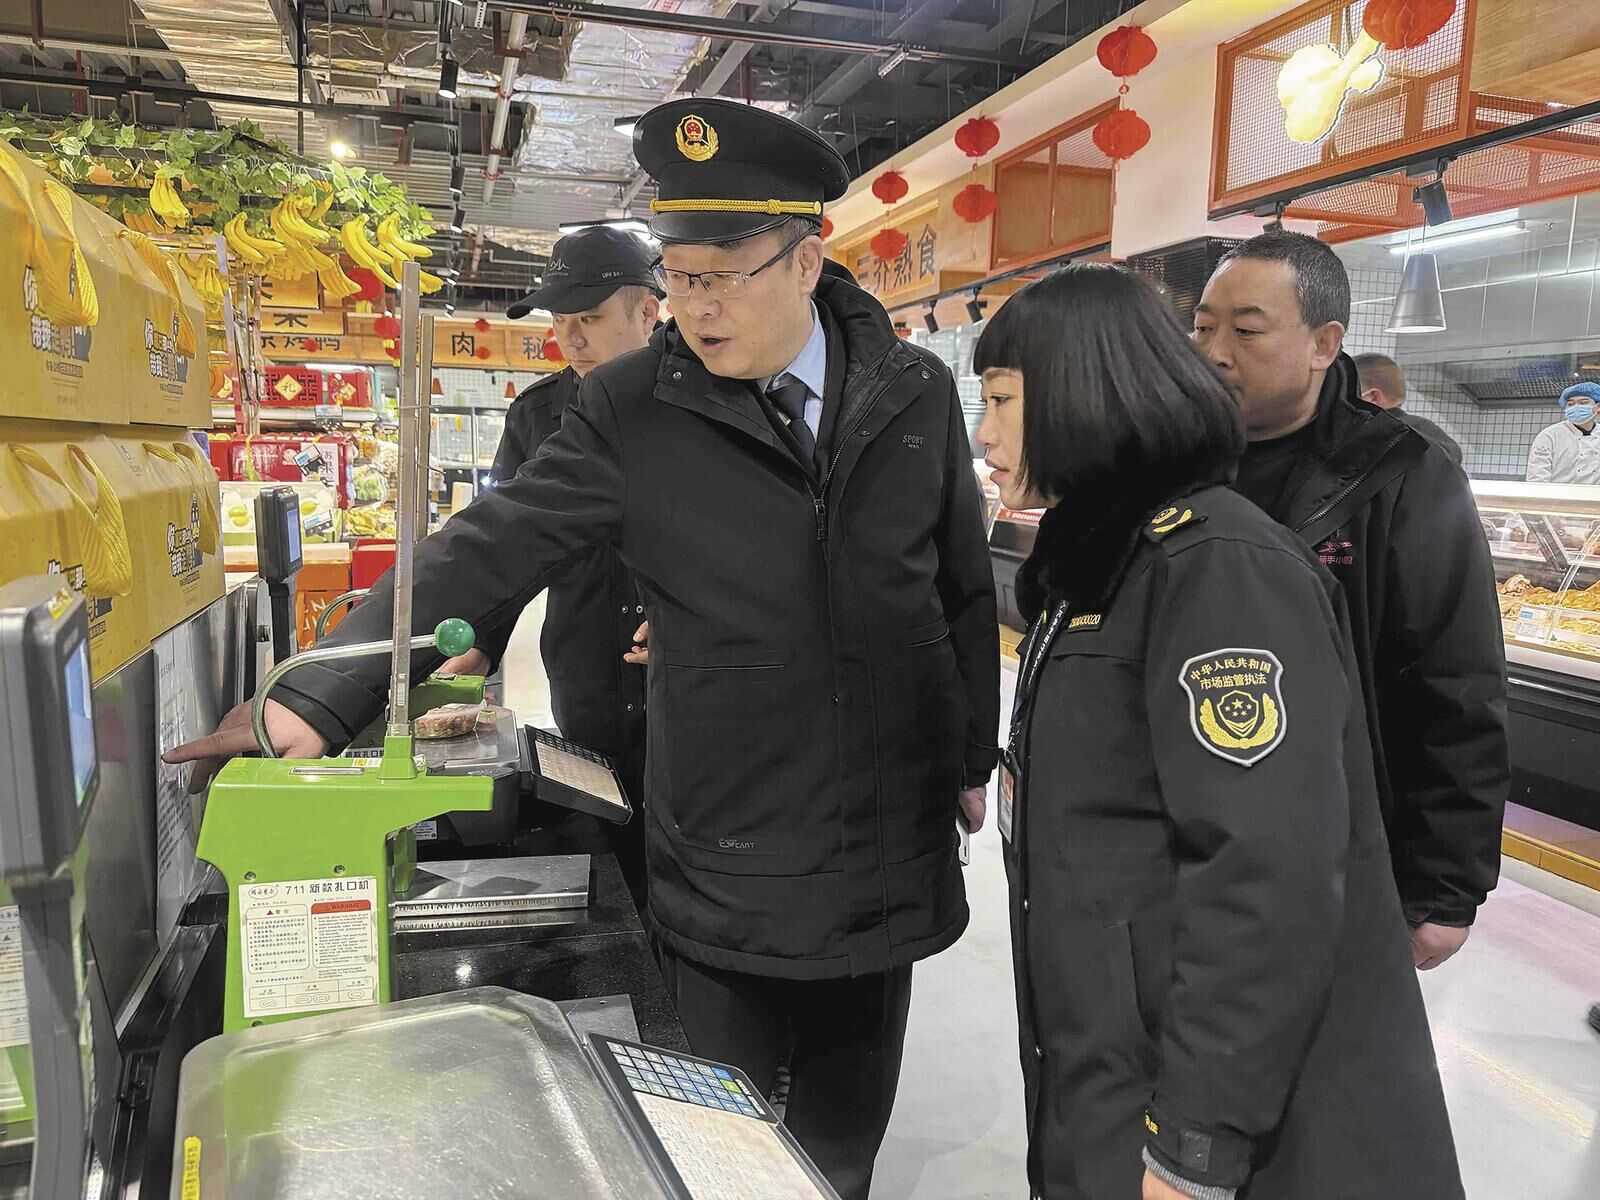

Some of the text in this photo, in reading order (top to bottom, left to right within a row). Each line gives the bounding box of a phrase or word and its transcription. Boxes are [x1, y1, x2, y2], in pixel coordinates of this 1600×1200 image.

[451, 331, 476, 358] 肉
[523, 336, 546, 361] 秘
[902, 434, 924, 445] SPORT
[1190, 657, 1272, 681] 中华人民共和国
[1200, 673, 1268, 690] 市场监管执法
[285, 885, 305, 895] 711
